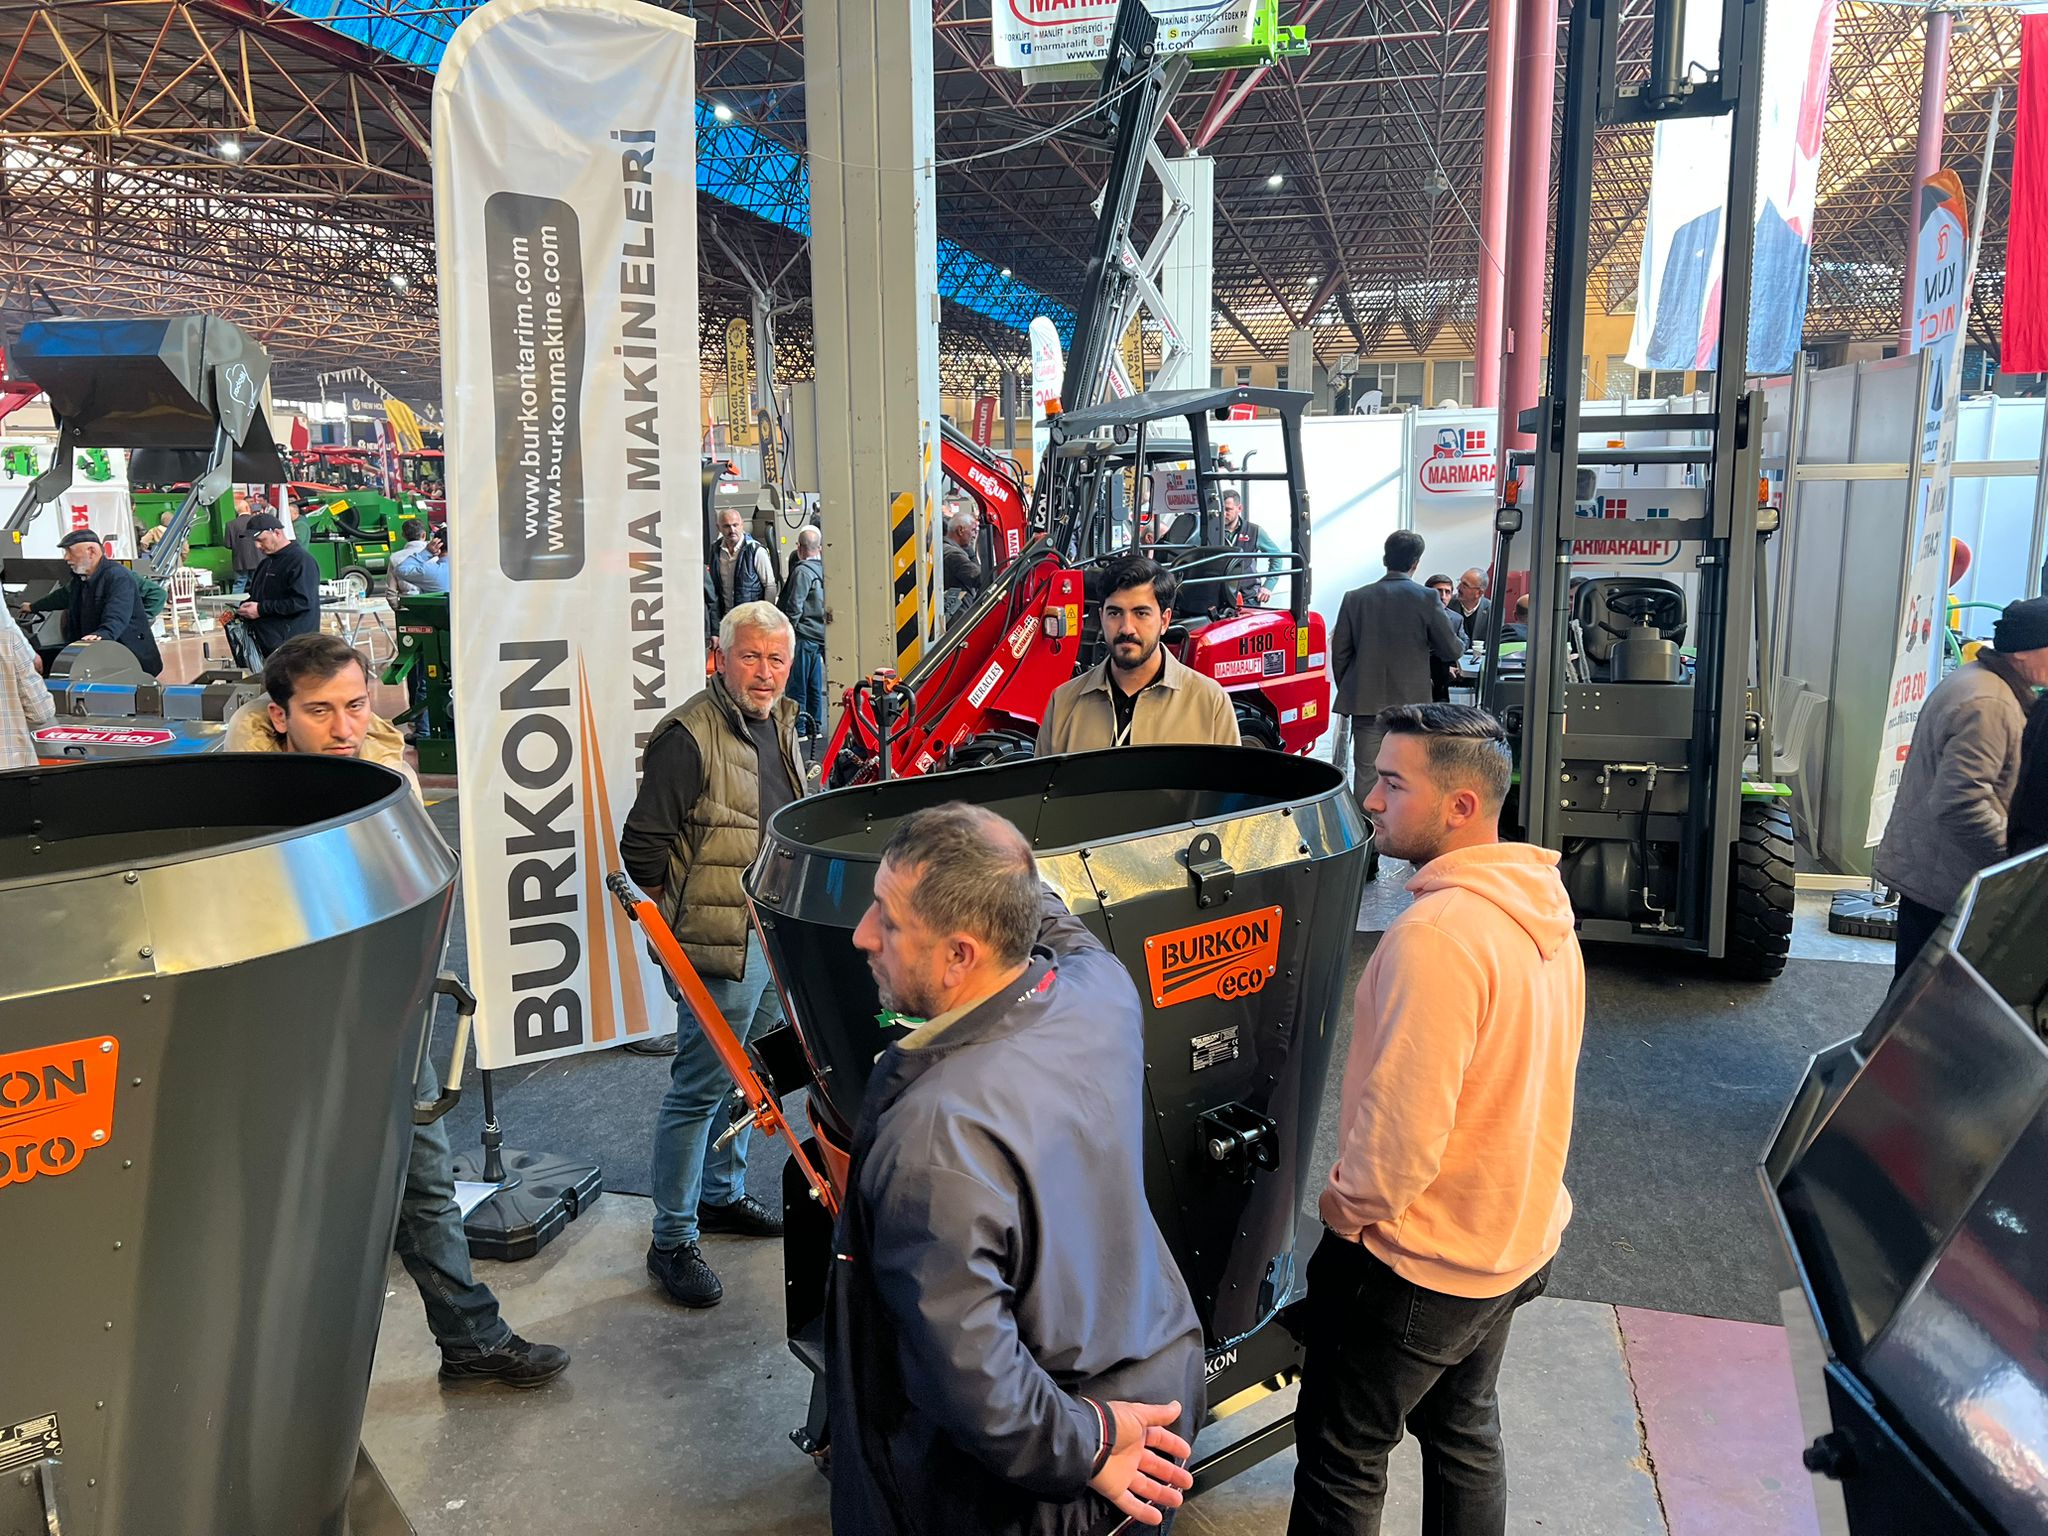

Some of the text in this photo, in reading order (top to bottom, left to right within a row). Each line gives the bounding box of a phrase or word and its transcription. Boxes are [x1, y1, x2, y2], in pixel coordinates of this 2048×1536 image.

[1034, 38, 1088, 52] marmaralift
[1039, 27, 1064, 38] MANLİFT
[610, 129, 661, 491] MAKİNELERİ
[512, 236, 541, 540] www.burkontarim.com
[540, 225, 567, 553] www.burkonmakine.com
[1428, 464, 1497, 484] MARMARA
[1167, 493, 1198, 506] MARMARALIF
[1572, 539, 1669, 555] ARMARALIFT
[627, 510, 667, 711] KARMA
[1215, 659, 1261, 677] MARMARALIFT
[970, 664, 1001, 705] HERACLES
[109, 734, 154, 743] 1500
[499, 640, 583, 1056] BURKON
[1162, 919, 1269, 969] BURKON
[1222, 968, 1263, 996] eco
[0, 1060, 87, 1109] ON
[1204, 1349, 1237, 1377] KON
